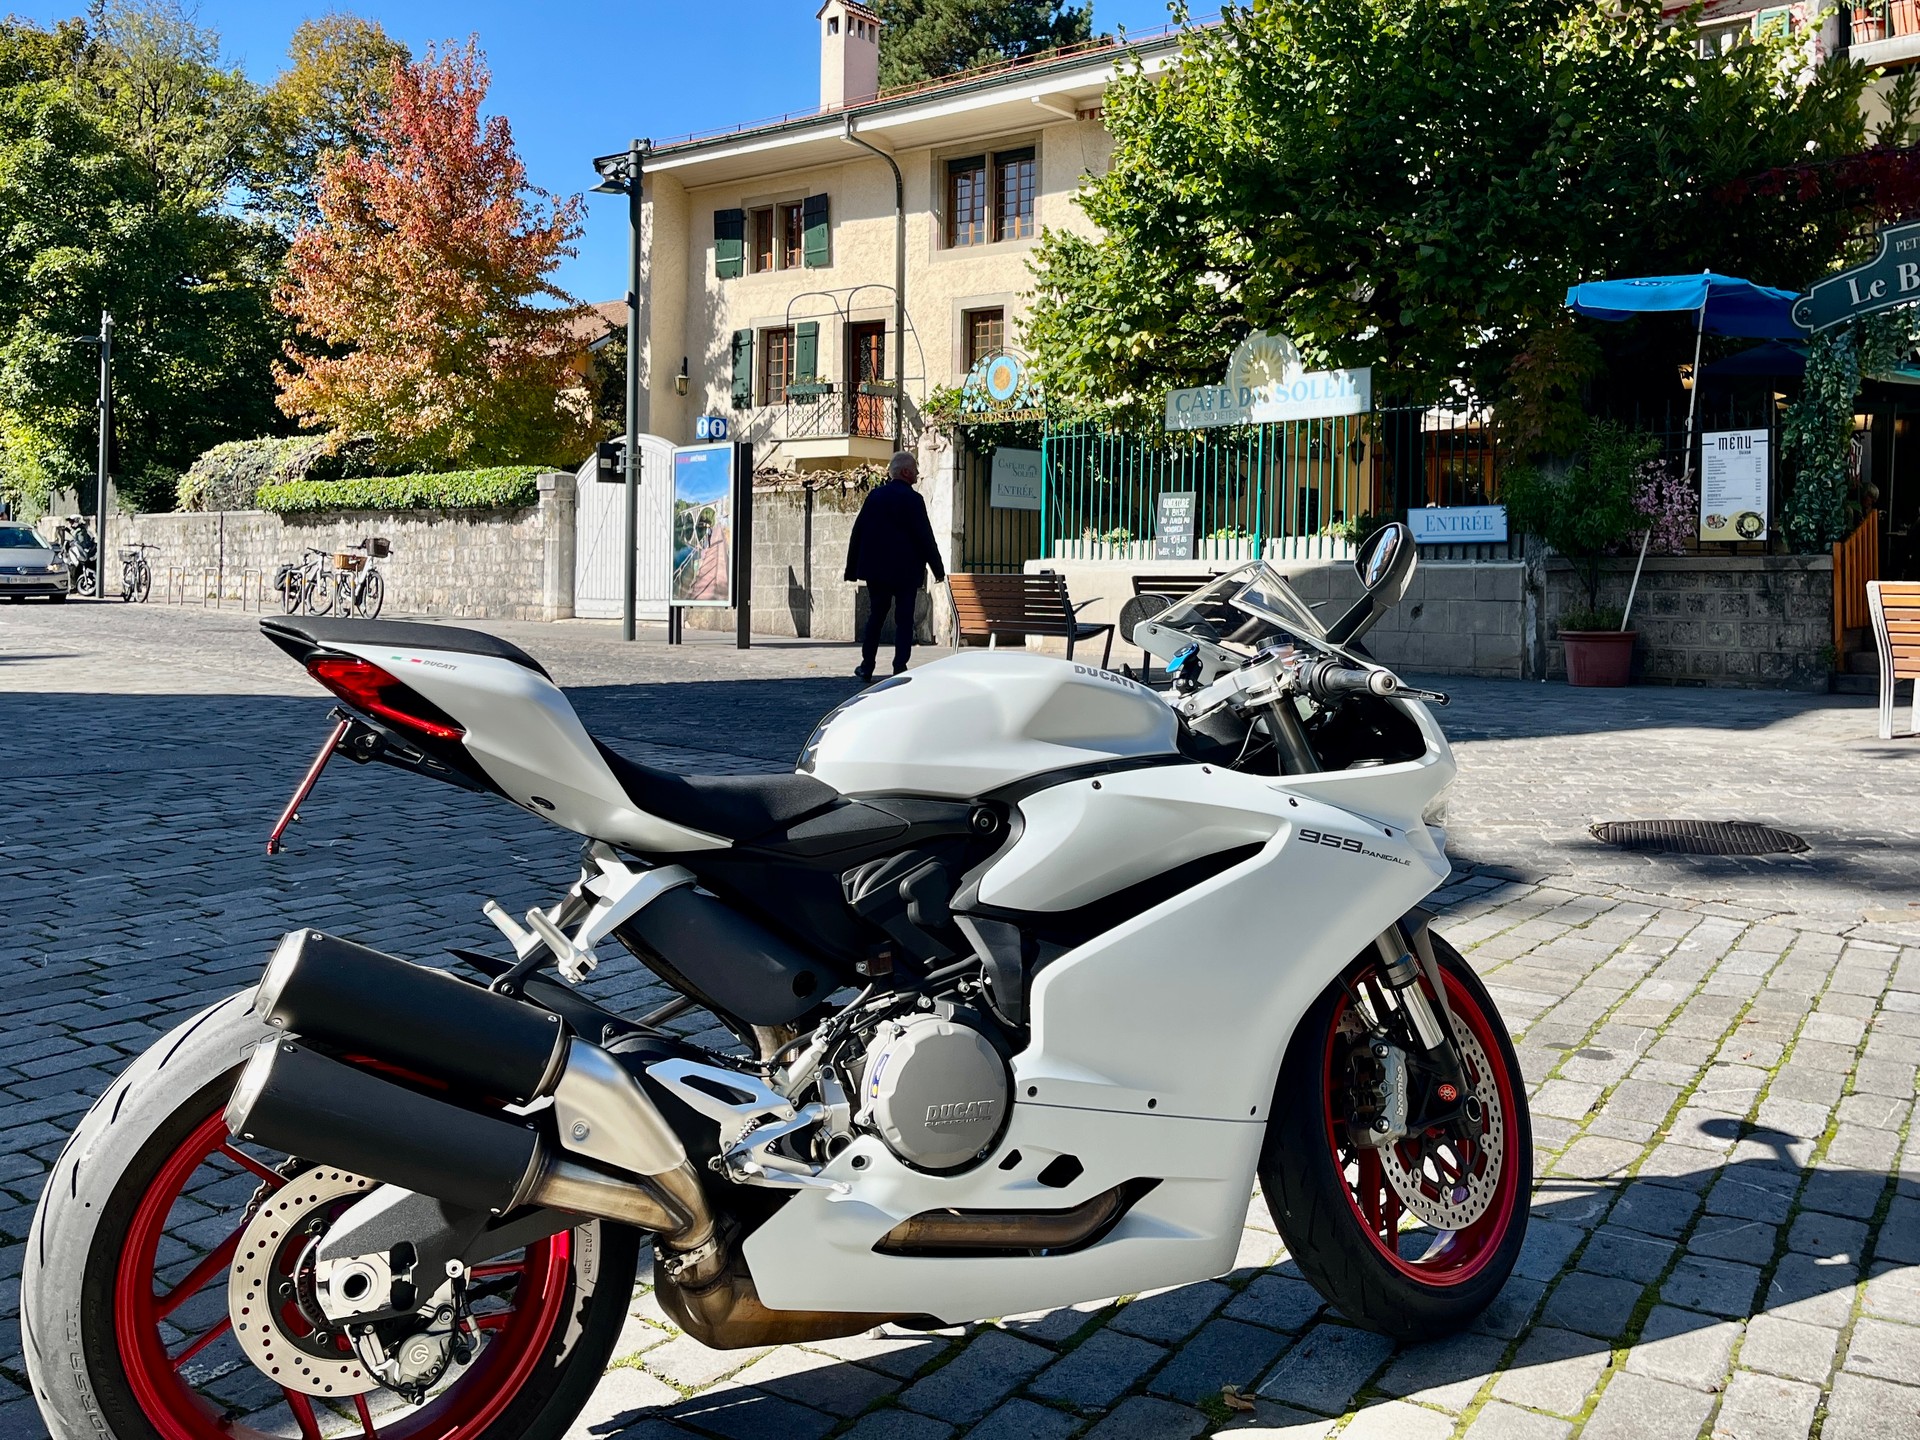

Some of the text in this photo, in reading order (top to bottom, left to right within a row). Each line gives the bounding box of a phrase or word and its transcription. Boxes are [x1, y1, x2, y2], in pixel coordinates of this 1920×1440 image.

[1895, 236, 1920, 252] PET
[1846, 262, 1920, 306] Le B
[1275, 373, 1361, 404] SOLEIL
[1013, 468, 1035, 477] SOLEIL
[997, 483, 1034, 496] ENTRÉE
[1426, 509, 1494, 532] ENTRÉE
[423, 660, 458, 671] DUCATI
[1074, 665, 1135, 690] DUCATI
[1298, 828, 1412, 867] 959 PANIGALE
[1395, 1065, 1405, 1116] brembo
[924, 1099, 996, 1122] DUCATI
